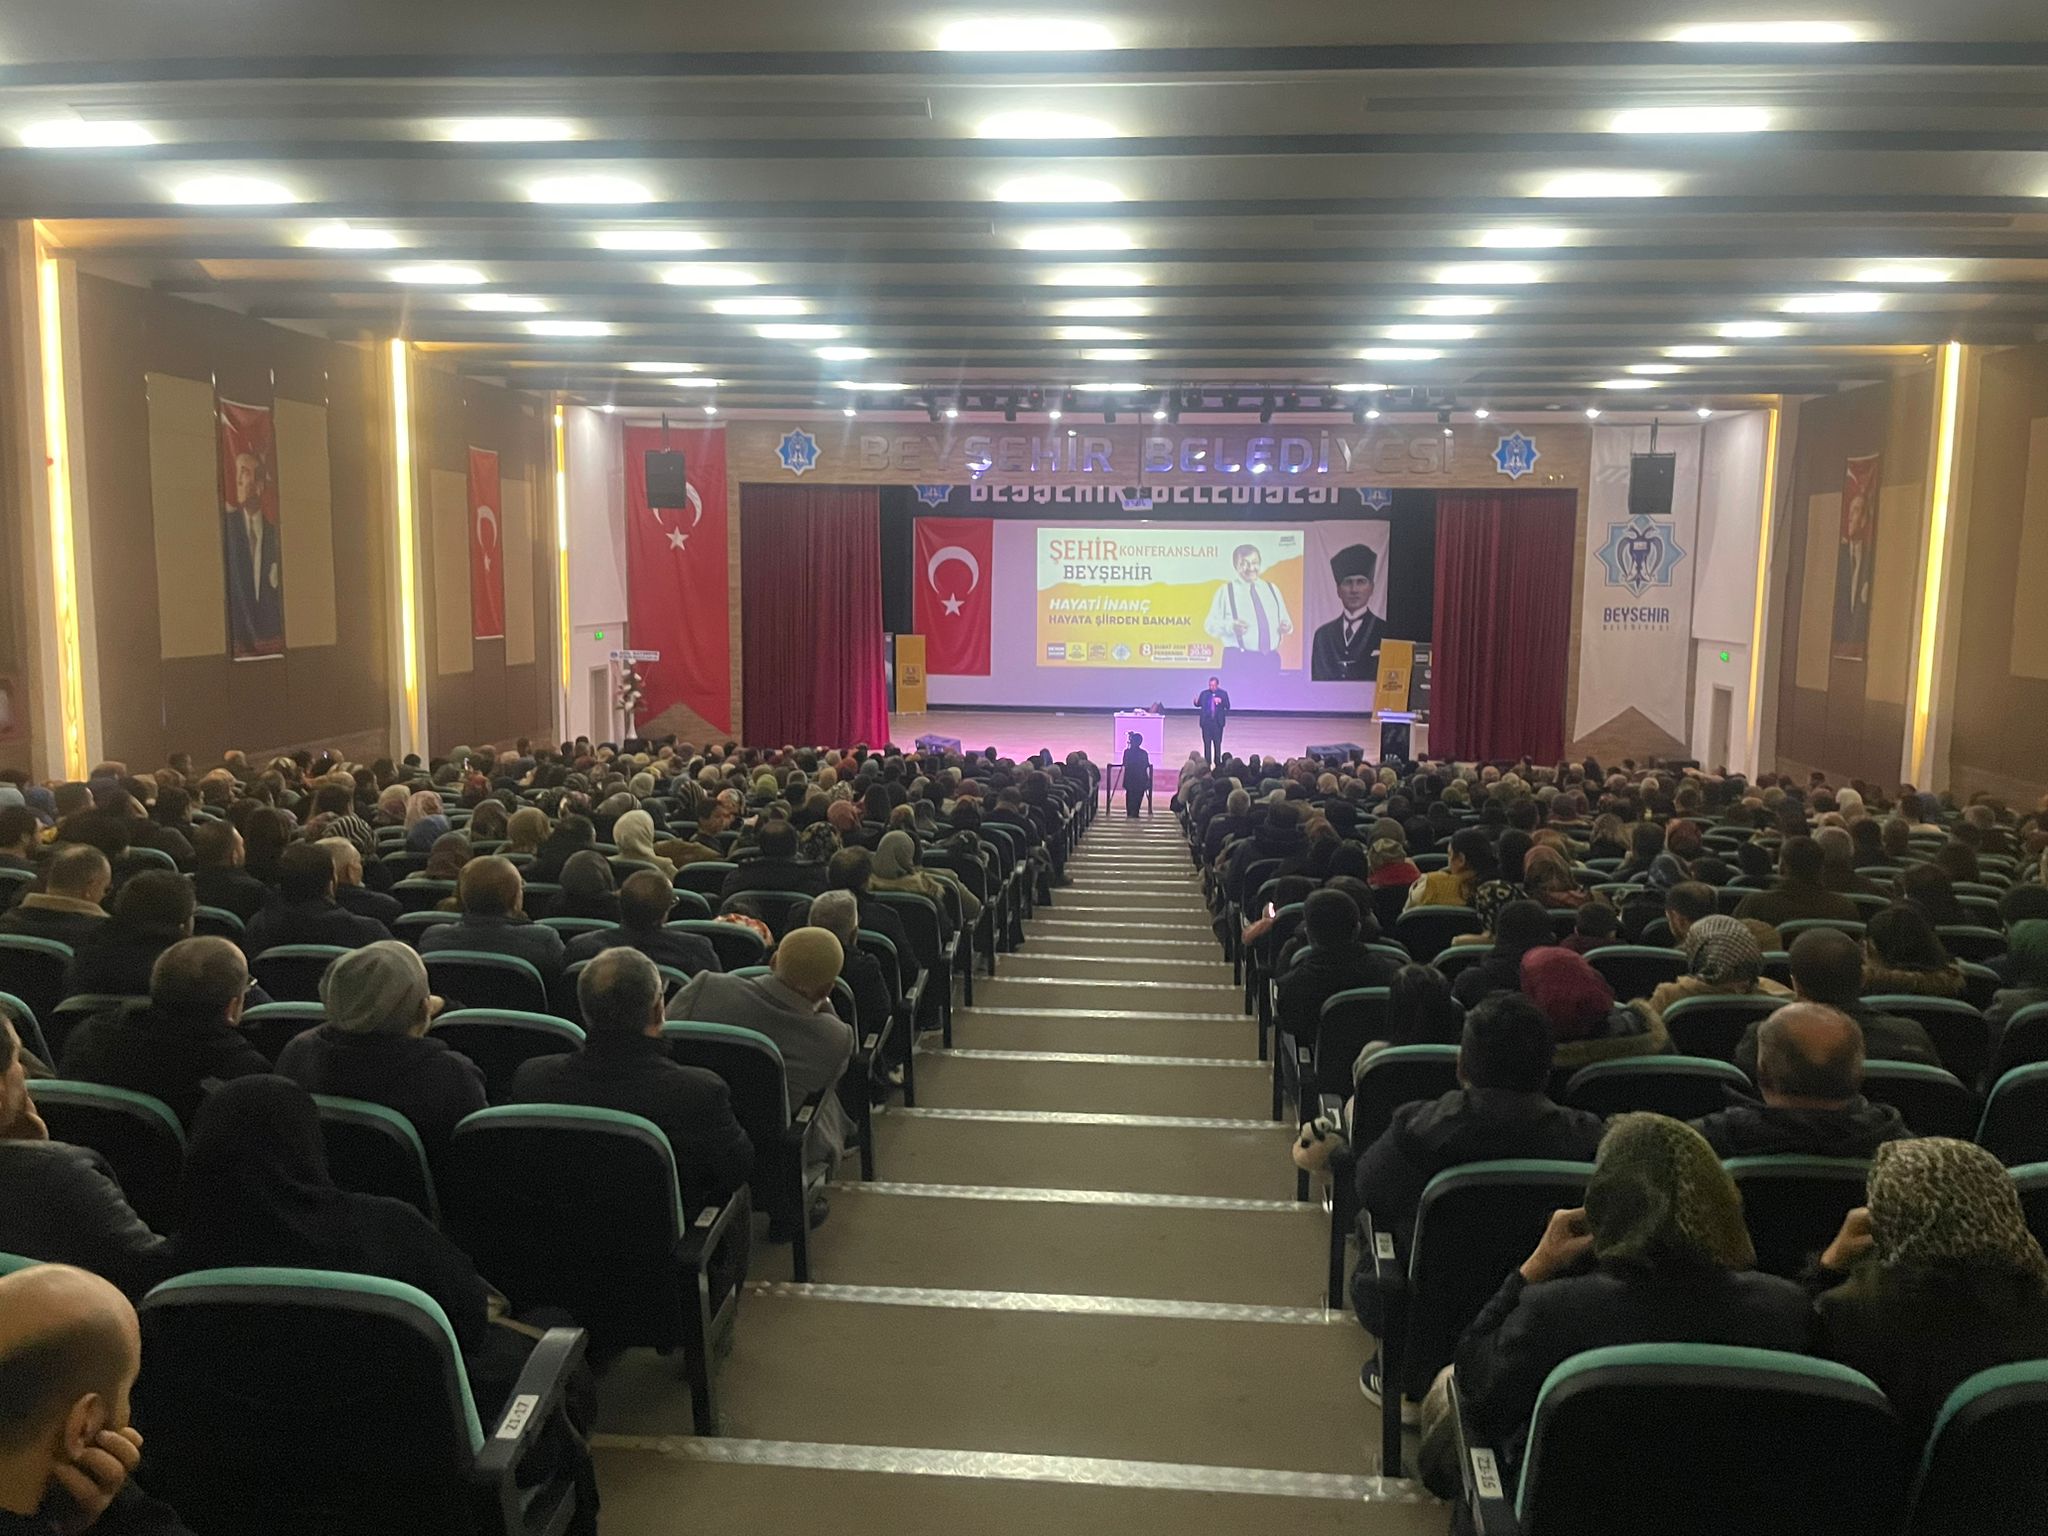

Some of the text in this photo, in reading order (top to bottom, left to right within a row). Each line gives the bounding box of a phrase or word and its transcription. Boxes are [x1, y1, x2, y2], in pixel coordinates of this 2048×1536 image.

[860, 428, 1455, 480] BEYŞEHİR BELEDİYESİ
[1050, 537, 1118, 564] ŞEHİR
[1063, 563, 1152, 583] BEYŞEHİR
[1049, 596, 1151, 613] HAYATİ İNANÇ
[1048, 615, 1092, 625] HAYATA
[1142, 616, 1192, 626] BAKMAK
[1142, 643, 1152, 656] 8
